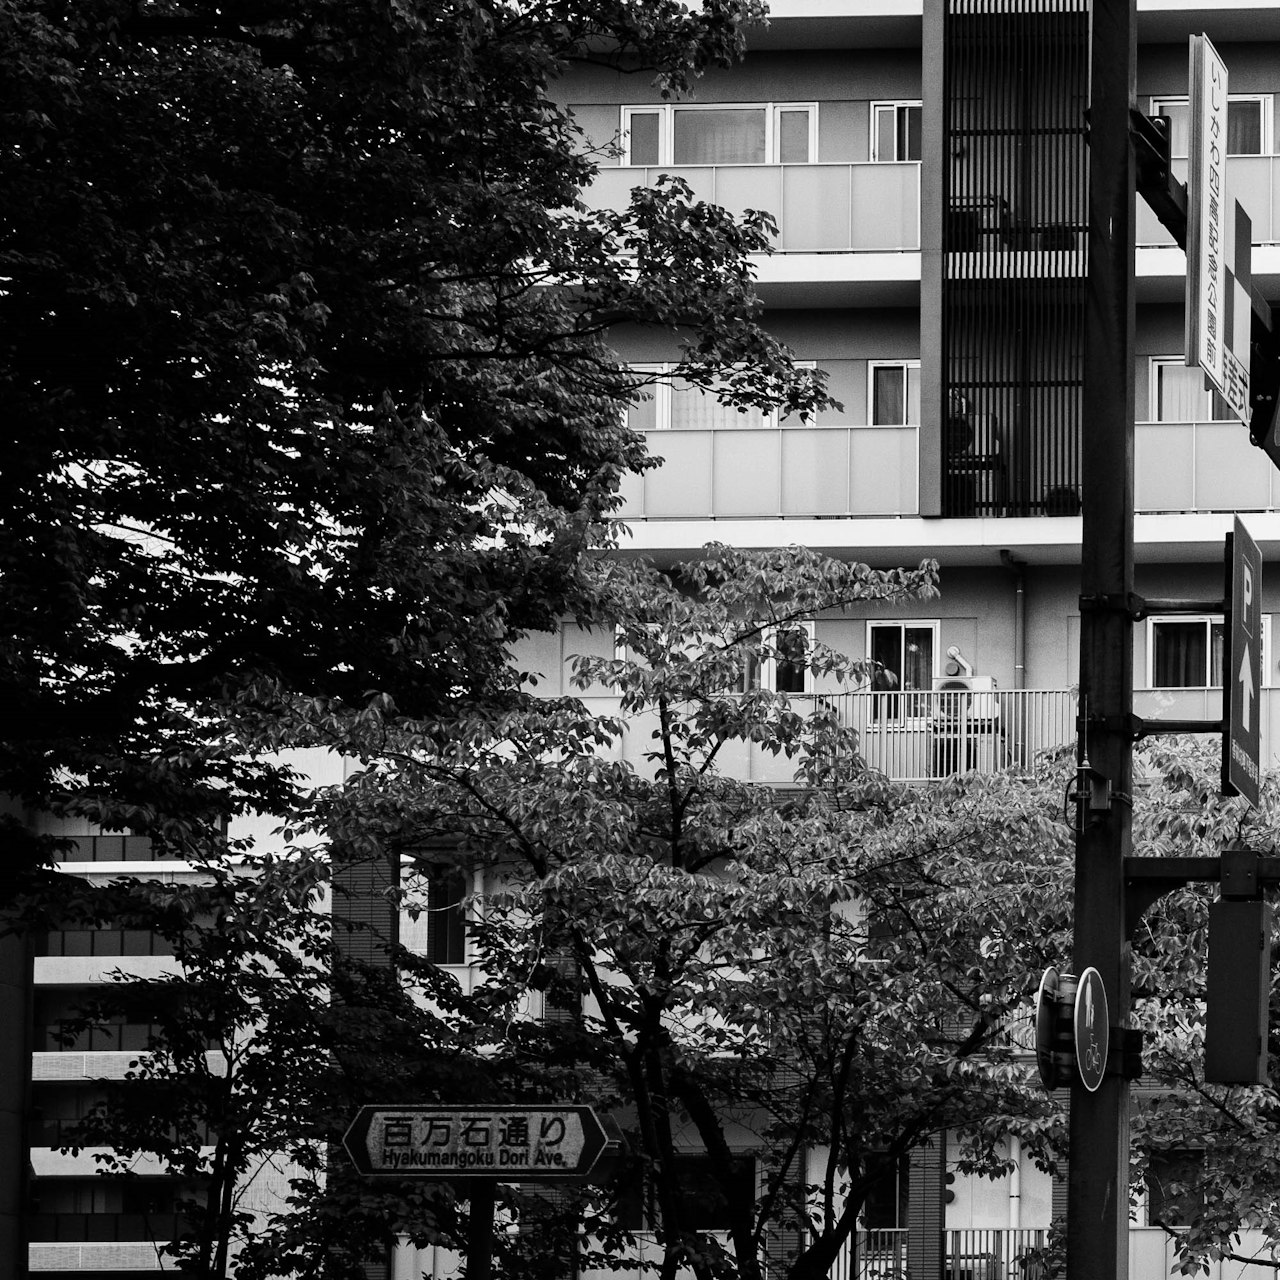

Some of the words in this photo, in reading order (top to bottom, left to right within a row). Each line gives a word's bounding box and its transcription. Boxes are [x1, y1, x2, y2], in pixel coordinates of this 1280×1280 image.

[1206, 61, 1221, 369] いしかわ四高記念公園前
[1243, 562, 1253, 624] P
[383, 1116, 567, 1147] 百万石通り
[383, 1149, 494, 1168] Hyakumangoku
[499, 1149, 529, 1166] Dori
[534, 1150, 568, 1167] Ave.
